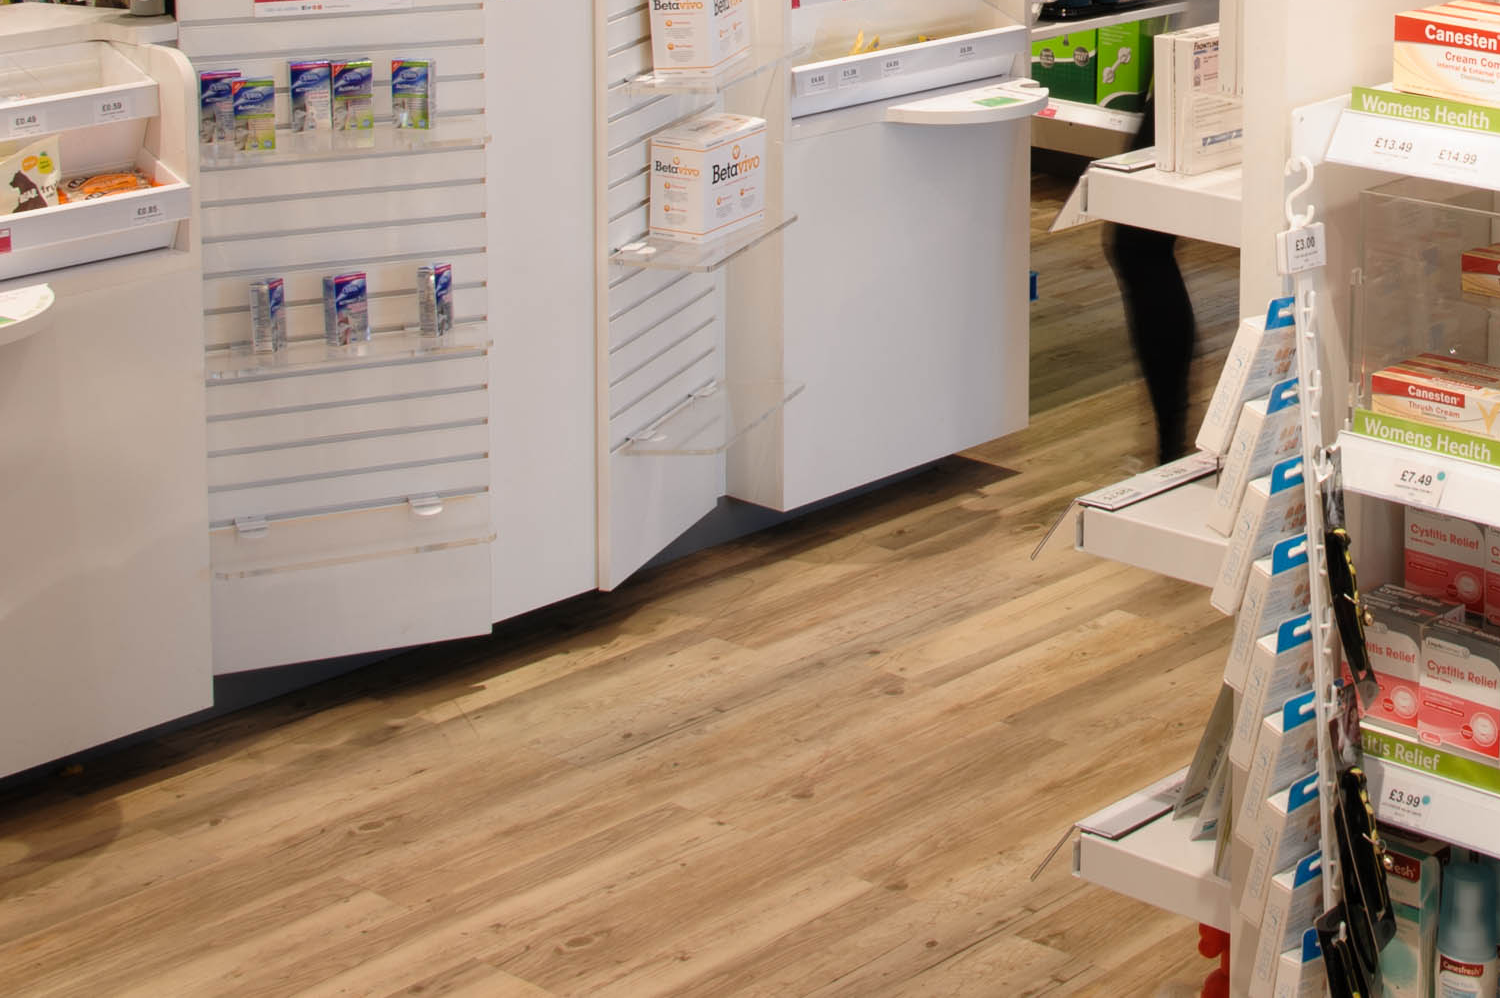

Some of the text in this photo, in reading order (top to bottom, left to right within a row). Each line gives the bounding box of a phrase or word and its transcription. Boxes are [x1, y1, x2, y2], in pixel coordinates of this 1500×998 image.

[653, 0, 703, 11] Betavivo
[1445, 51, 1478, 67] Cream
[1361, 93, 1489, 129] Womens Health
[1374, 137, 1413, 153] £13.49
[1438, 149, 1477, 165] £14.99
[712, 154, 760, 185] Betavivo
[1295, 235, 1316, 252] £3.00
[1364, 416, 1491, 462] Womens Health
[1400, 468, 1433, 487] £7.49
[1427, 660, 1498, 690] Cystitis Relief
[1394, 742, 1440, 771] Relief
[1389, 788, 1421, 808] £3.99
